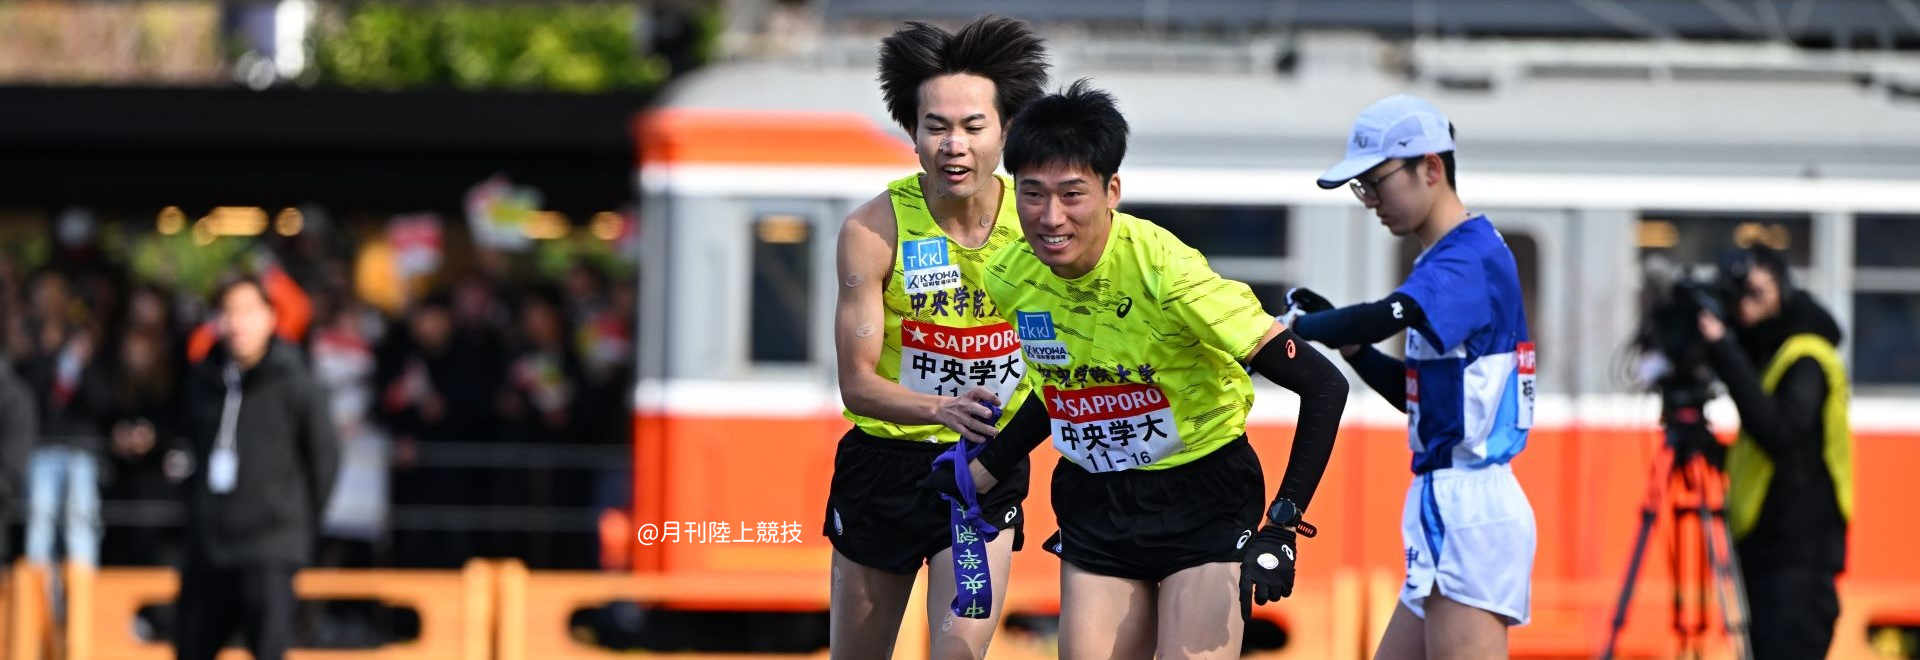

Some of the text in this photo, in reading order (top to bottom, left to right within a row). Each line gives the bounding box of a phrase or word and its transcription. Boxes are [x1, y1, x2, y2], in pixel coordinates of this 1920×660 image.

[907, 241, 942, 268] TKK
[920, 270, 959, 283] KYOWA
[1033, 347, 1067, 355] KYOWA
[912, 353, 1020, 386] 中央学大
[1066, 389, 1162, 418] SAPPORO
[1061, 415, 1168, 451] 中央学大
[1087, 451, 1151, 471] 11-16
